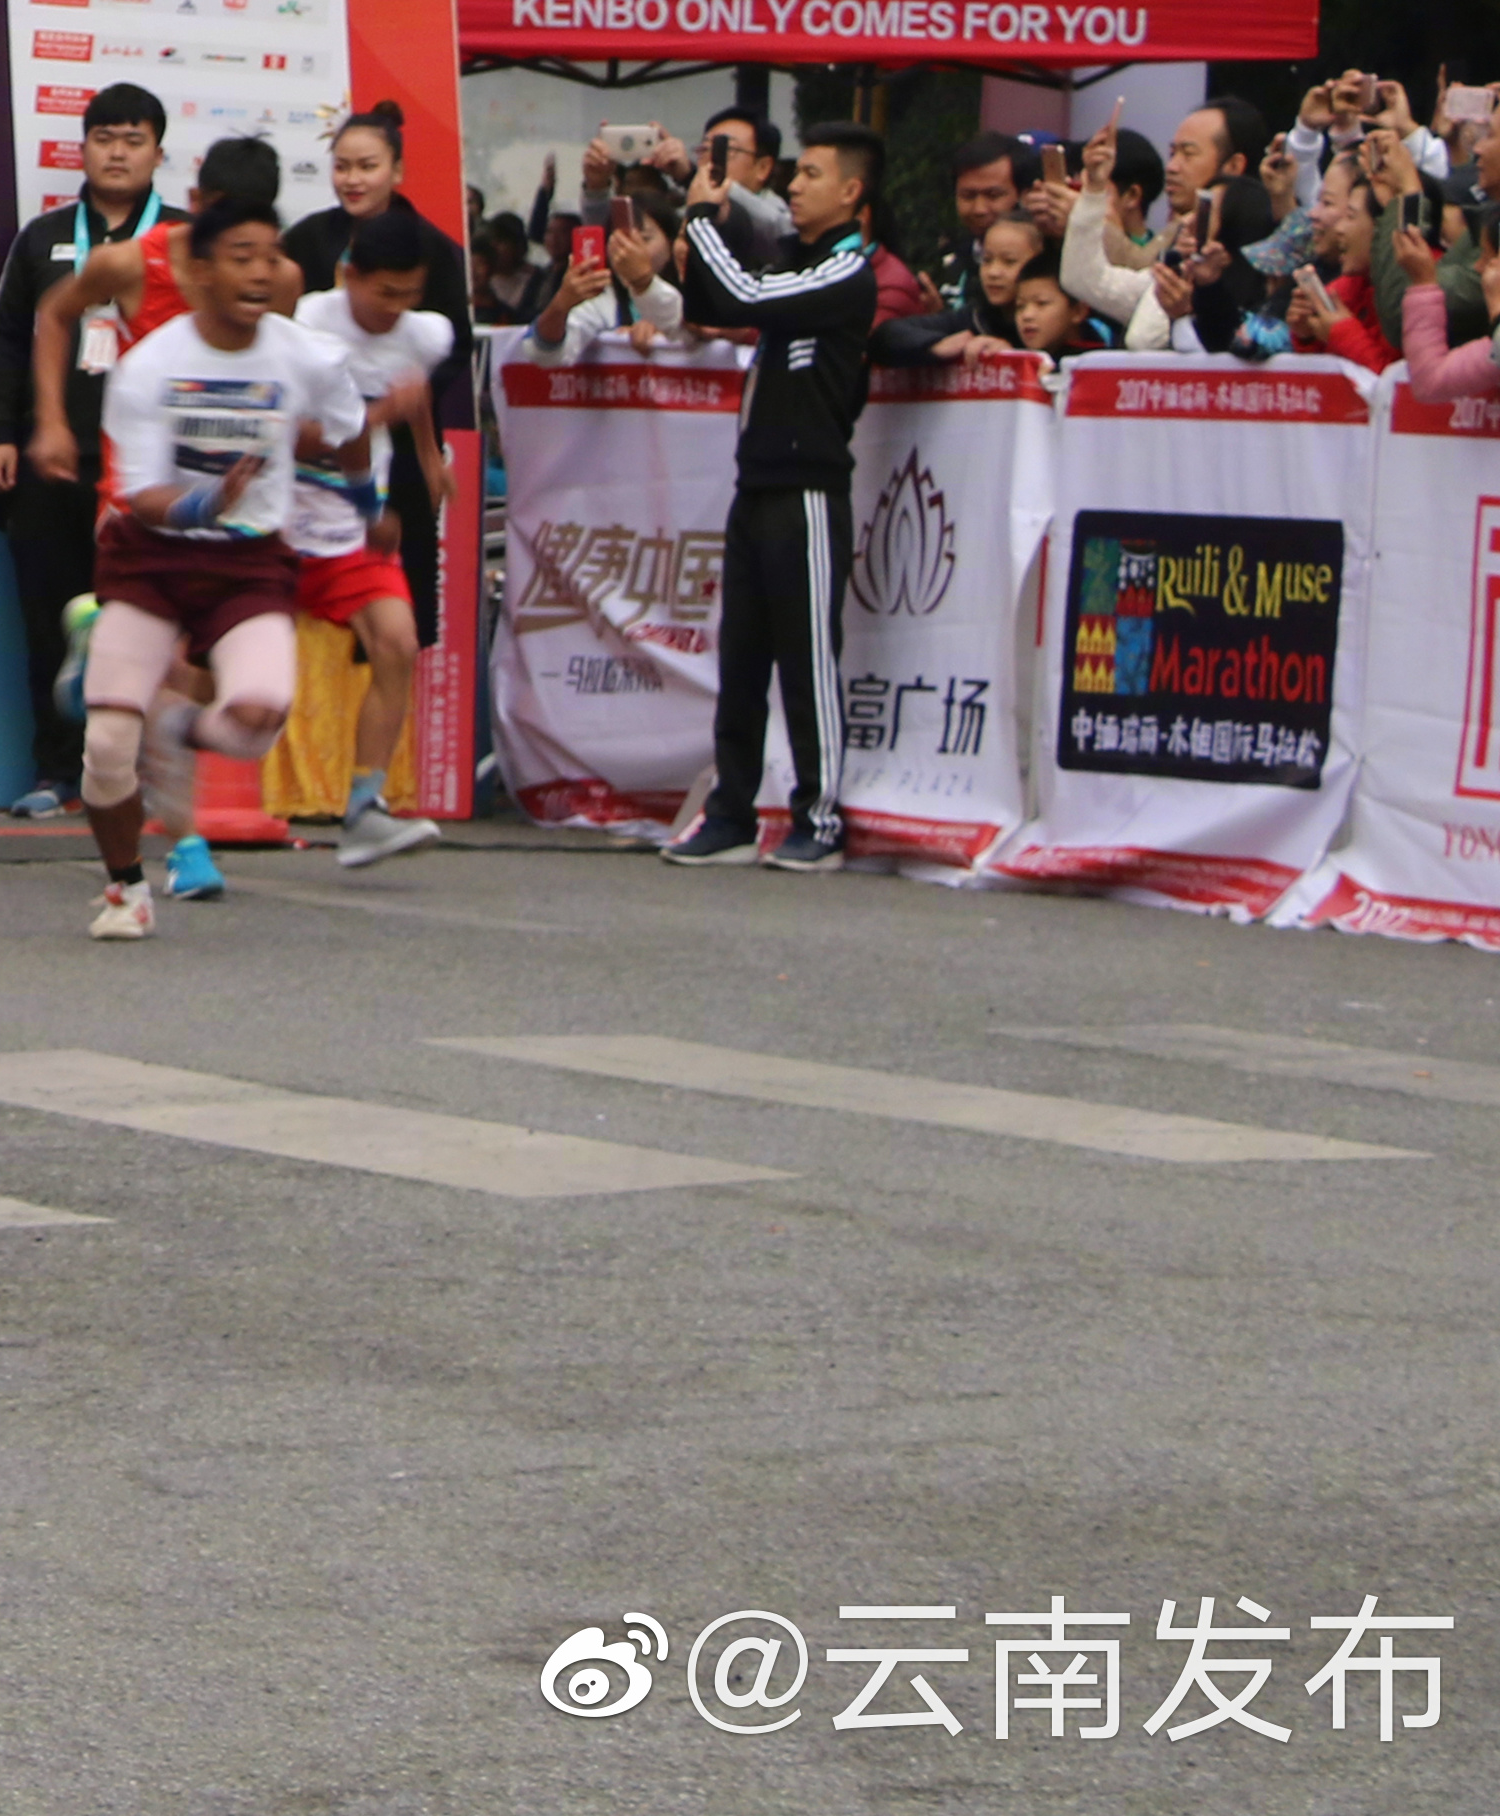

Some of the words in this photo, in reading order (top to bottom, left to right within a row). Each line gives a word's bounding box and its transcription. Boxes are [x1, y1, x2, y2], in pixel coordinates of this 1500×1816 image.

[962, 0, 1051, 44] FOR
[1056, 5, 1148, 48] YOU
[1154, 543, 1221, 616] Ruili
[1222, 543, 1250, 617] &
[1253, 558, 1333, 619] Muse
[1149, 631, 1328, 705] Marathon
